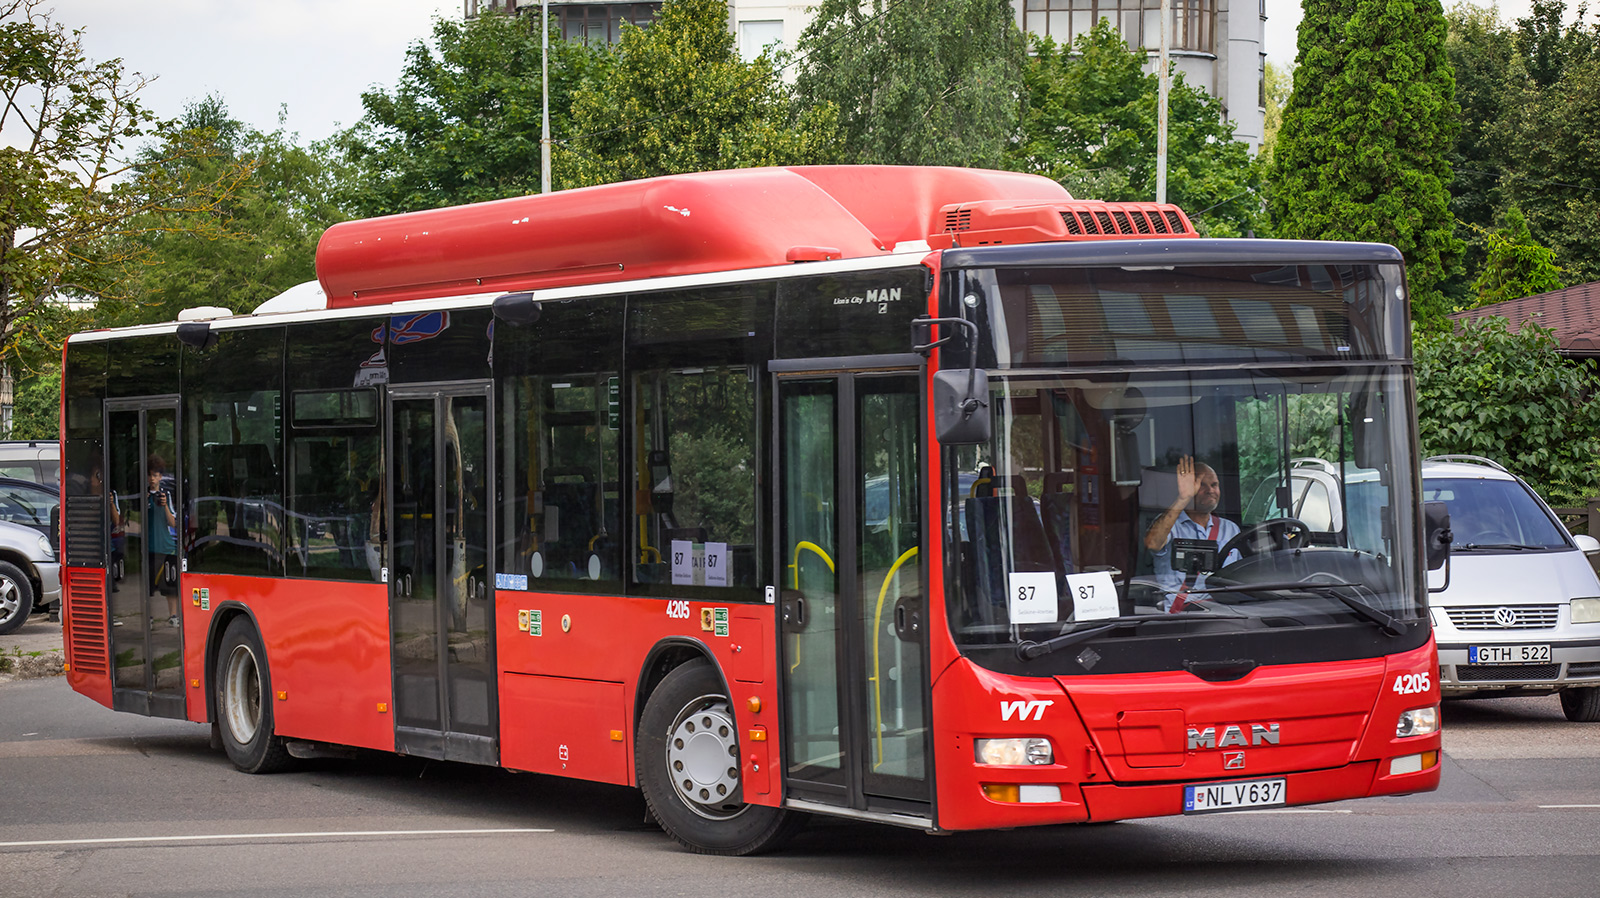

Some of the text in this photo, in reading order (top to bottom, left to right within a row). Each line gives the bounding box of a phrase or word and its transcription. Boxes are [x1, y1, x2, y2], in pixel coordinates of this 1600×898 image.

[850, 296, 864, 304] City
[866, 288, 901, 302] MAN
[675, 552, 683, 565] 87
[708, 554, 717, 567] 87
[1018, 586, 1036, 600] 87
[1078, 585, 1095, 600] 87
[666, 600, 690, 619] 4205
[1480, 646, 1548, 661] GTH 522
[1393, 672, 1431, 695] 4205
[1000, 700, 1055, 721] VVT
[1187, 724, 1279, 749] MAN
[1207, 783, 1281, 806] NLV637
